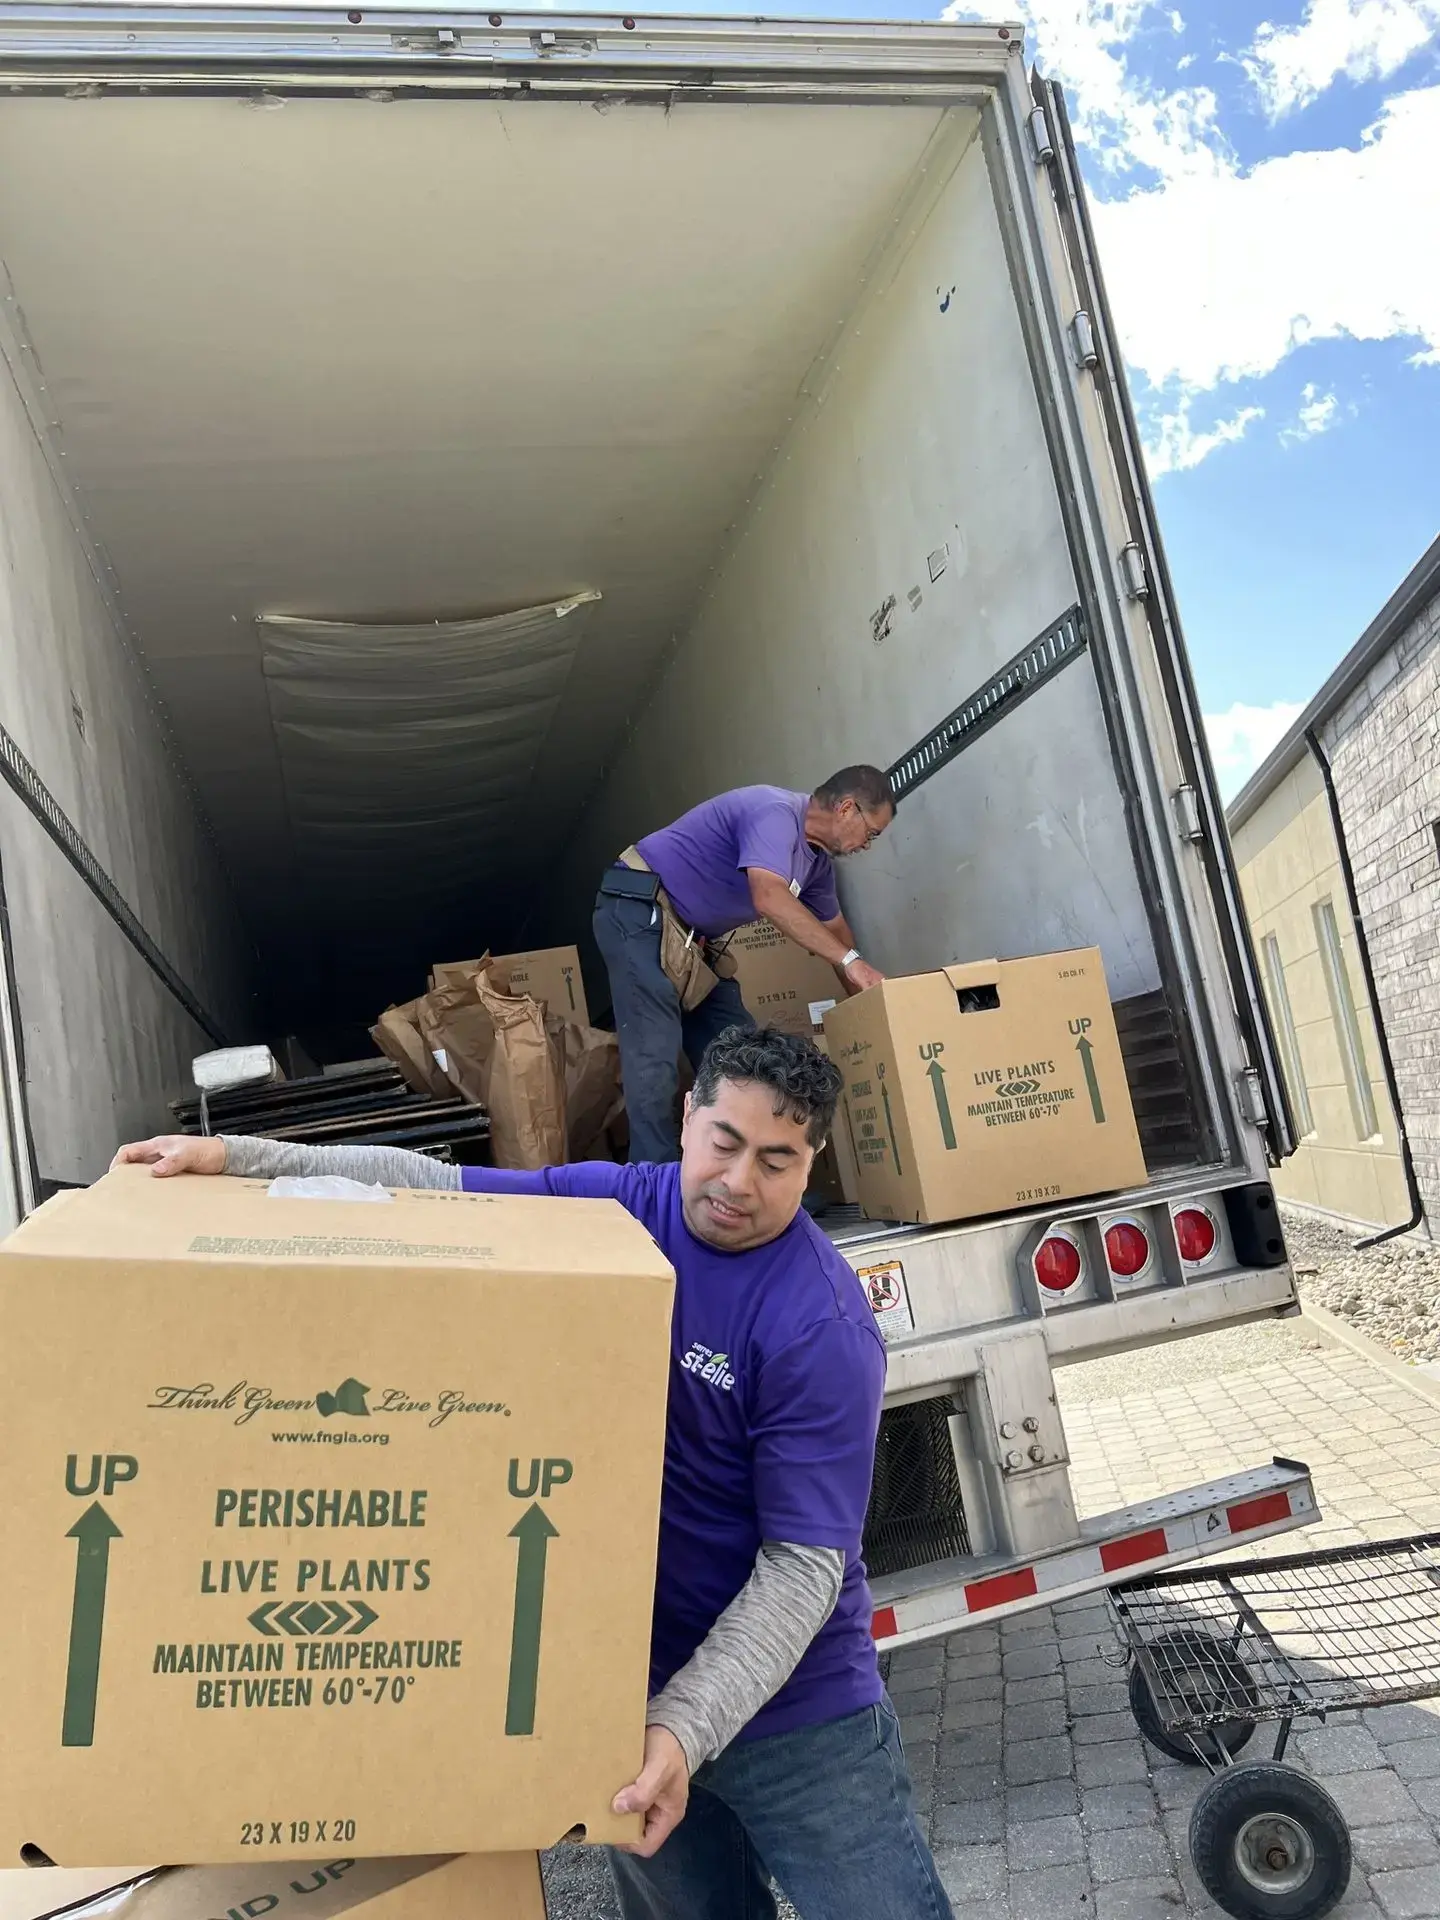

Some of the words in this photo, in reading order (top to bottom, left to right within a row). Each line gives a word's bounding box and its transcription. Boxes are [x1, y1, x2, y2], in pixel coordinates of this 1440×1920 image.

[1067, 1017, 1092, 1035] UP
[918, 1042, 945, 1061] UP
[974, 1069, 1002, 1086] LIVE
[1007, 1060, 1056, 1080] PLANTS
[967, 1100, 1013, 1116] MAINTAIN
[1014, 1088, 1076, 1108] TEMPERATURE
[985, 1109, 1027, 1127] BETWEEN
[1016, 1191, 1026, 1201] 23
[1027, 1189, 1032, 1199] X
[1035, 1187, 1043, 1198] 19
[1044, 1186, 1050, 1197] X
[1051, 1185, 1061, 1195] 20
[147, 1380, 247, 1410] Think
[234, 1387, 318, 1426] Green
[372, 1389, 432, 1412] Live
[272, 1430, 390, 1445] www.fngla.org
[65, 1454, 139, 1496] UP
[507, 1457, 573, 1498] UP
[214, 1489, 427, 1527] PERISHABLE
[200, 1559, 279, 1593] LIVE
[296, 1559, 431, 1592] PLANTS
[152, 1643, 284, 1674] MAINTAIN
[295, 1640, 463, 1671] TEMPERATURE
[196, 1678, 313, 1708] BETWEEN
[322, 1676, 416, 1706] 60°-70°
[240, 1822, 264, 1845] 23
[269, 1821, 282, 1844] X
[289, 1820, 310, 1843] 19
[315, 1820, 327, 1842] X
[333, 1819, 356, 1841] 20
[289, 1858, 356, 1894] UP
